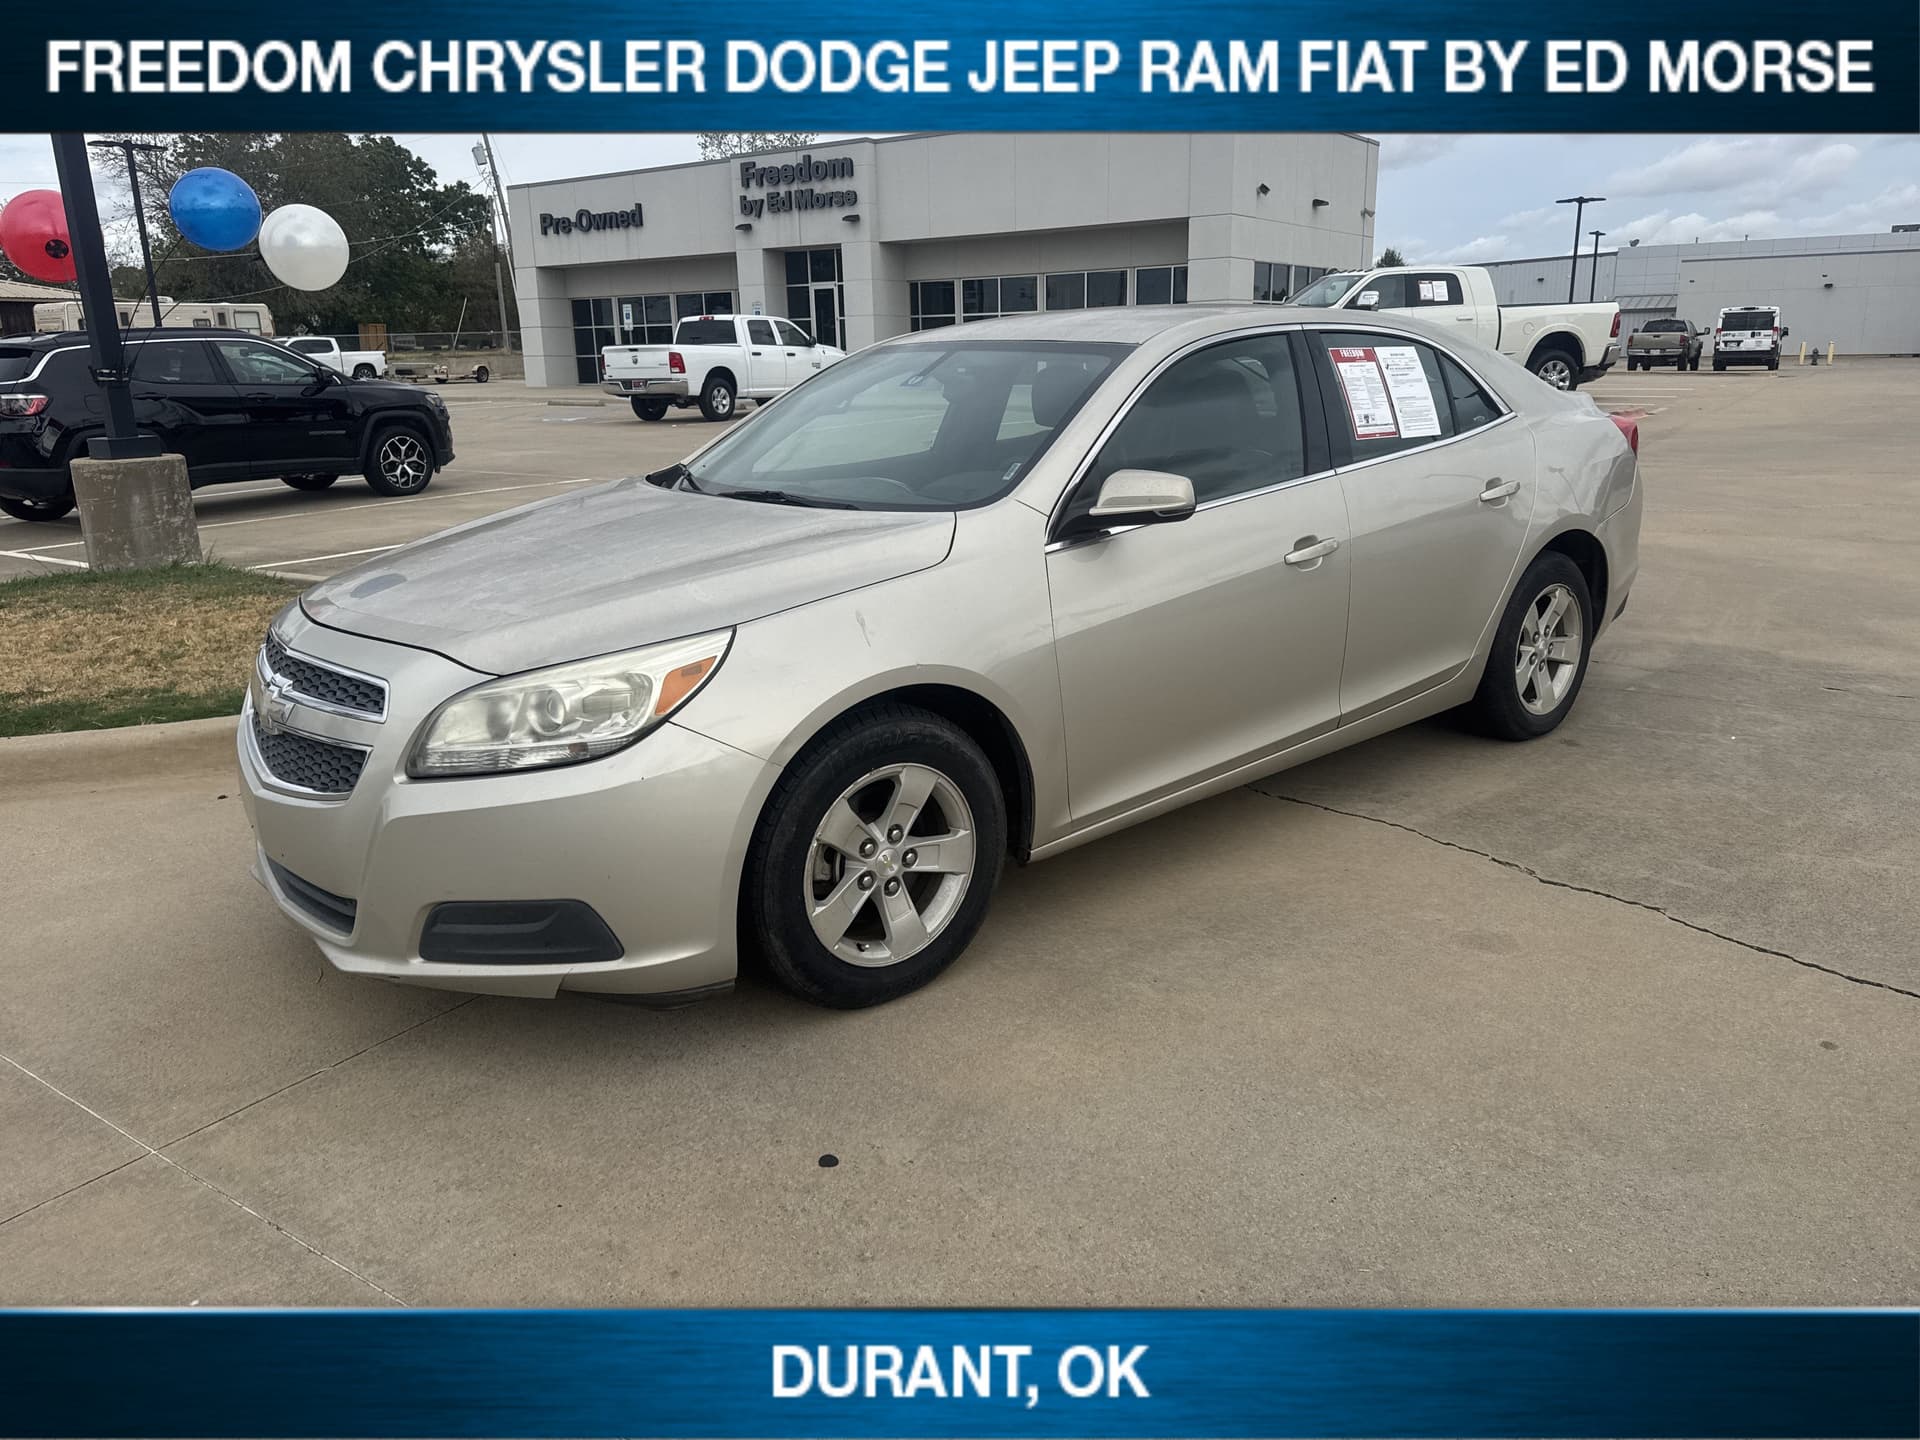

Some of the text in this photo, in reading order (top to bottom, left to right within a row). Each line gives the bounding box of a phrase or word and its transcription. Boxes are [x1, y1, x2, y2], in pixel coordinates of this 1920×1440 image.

[740, 154, 854, 188] Freedom
[540, 203, 644, 236] Pre-Owned
[740, 188, 857, 219] by Ed Morse
